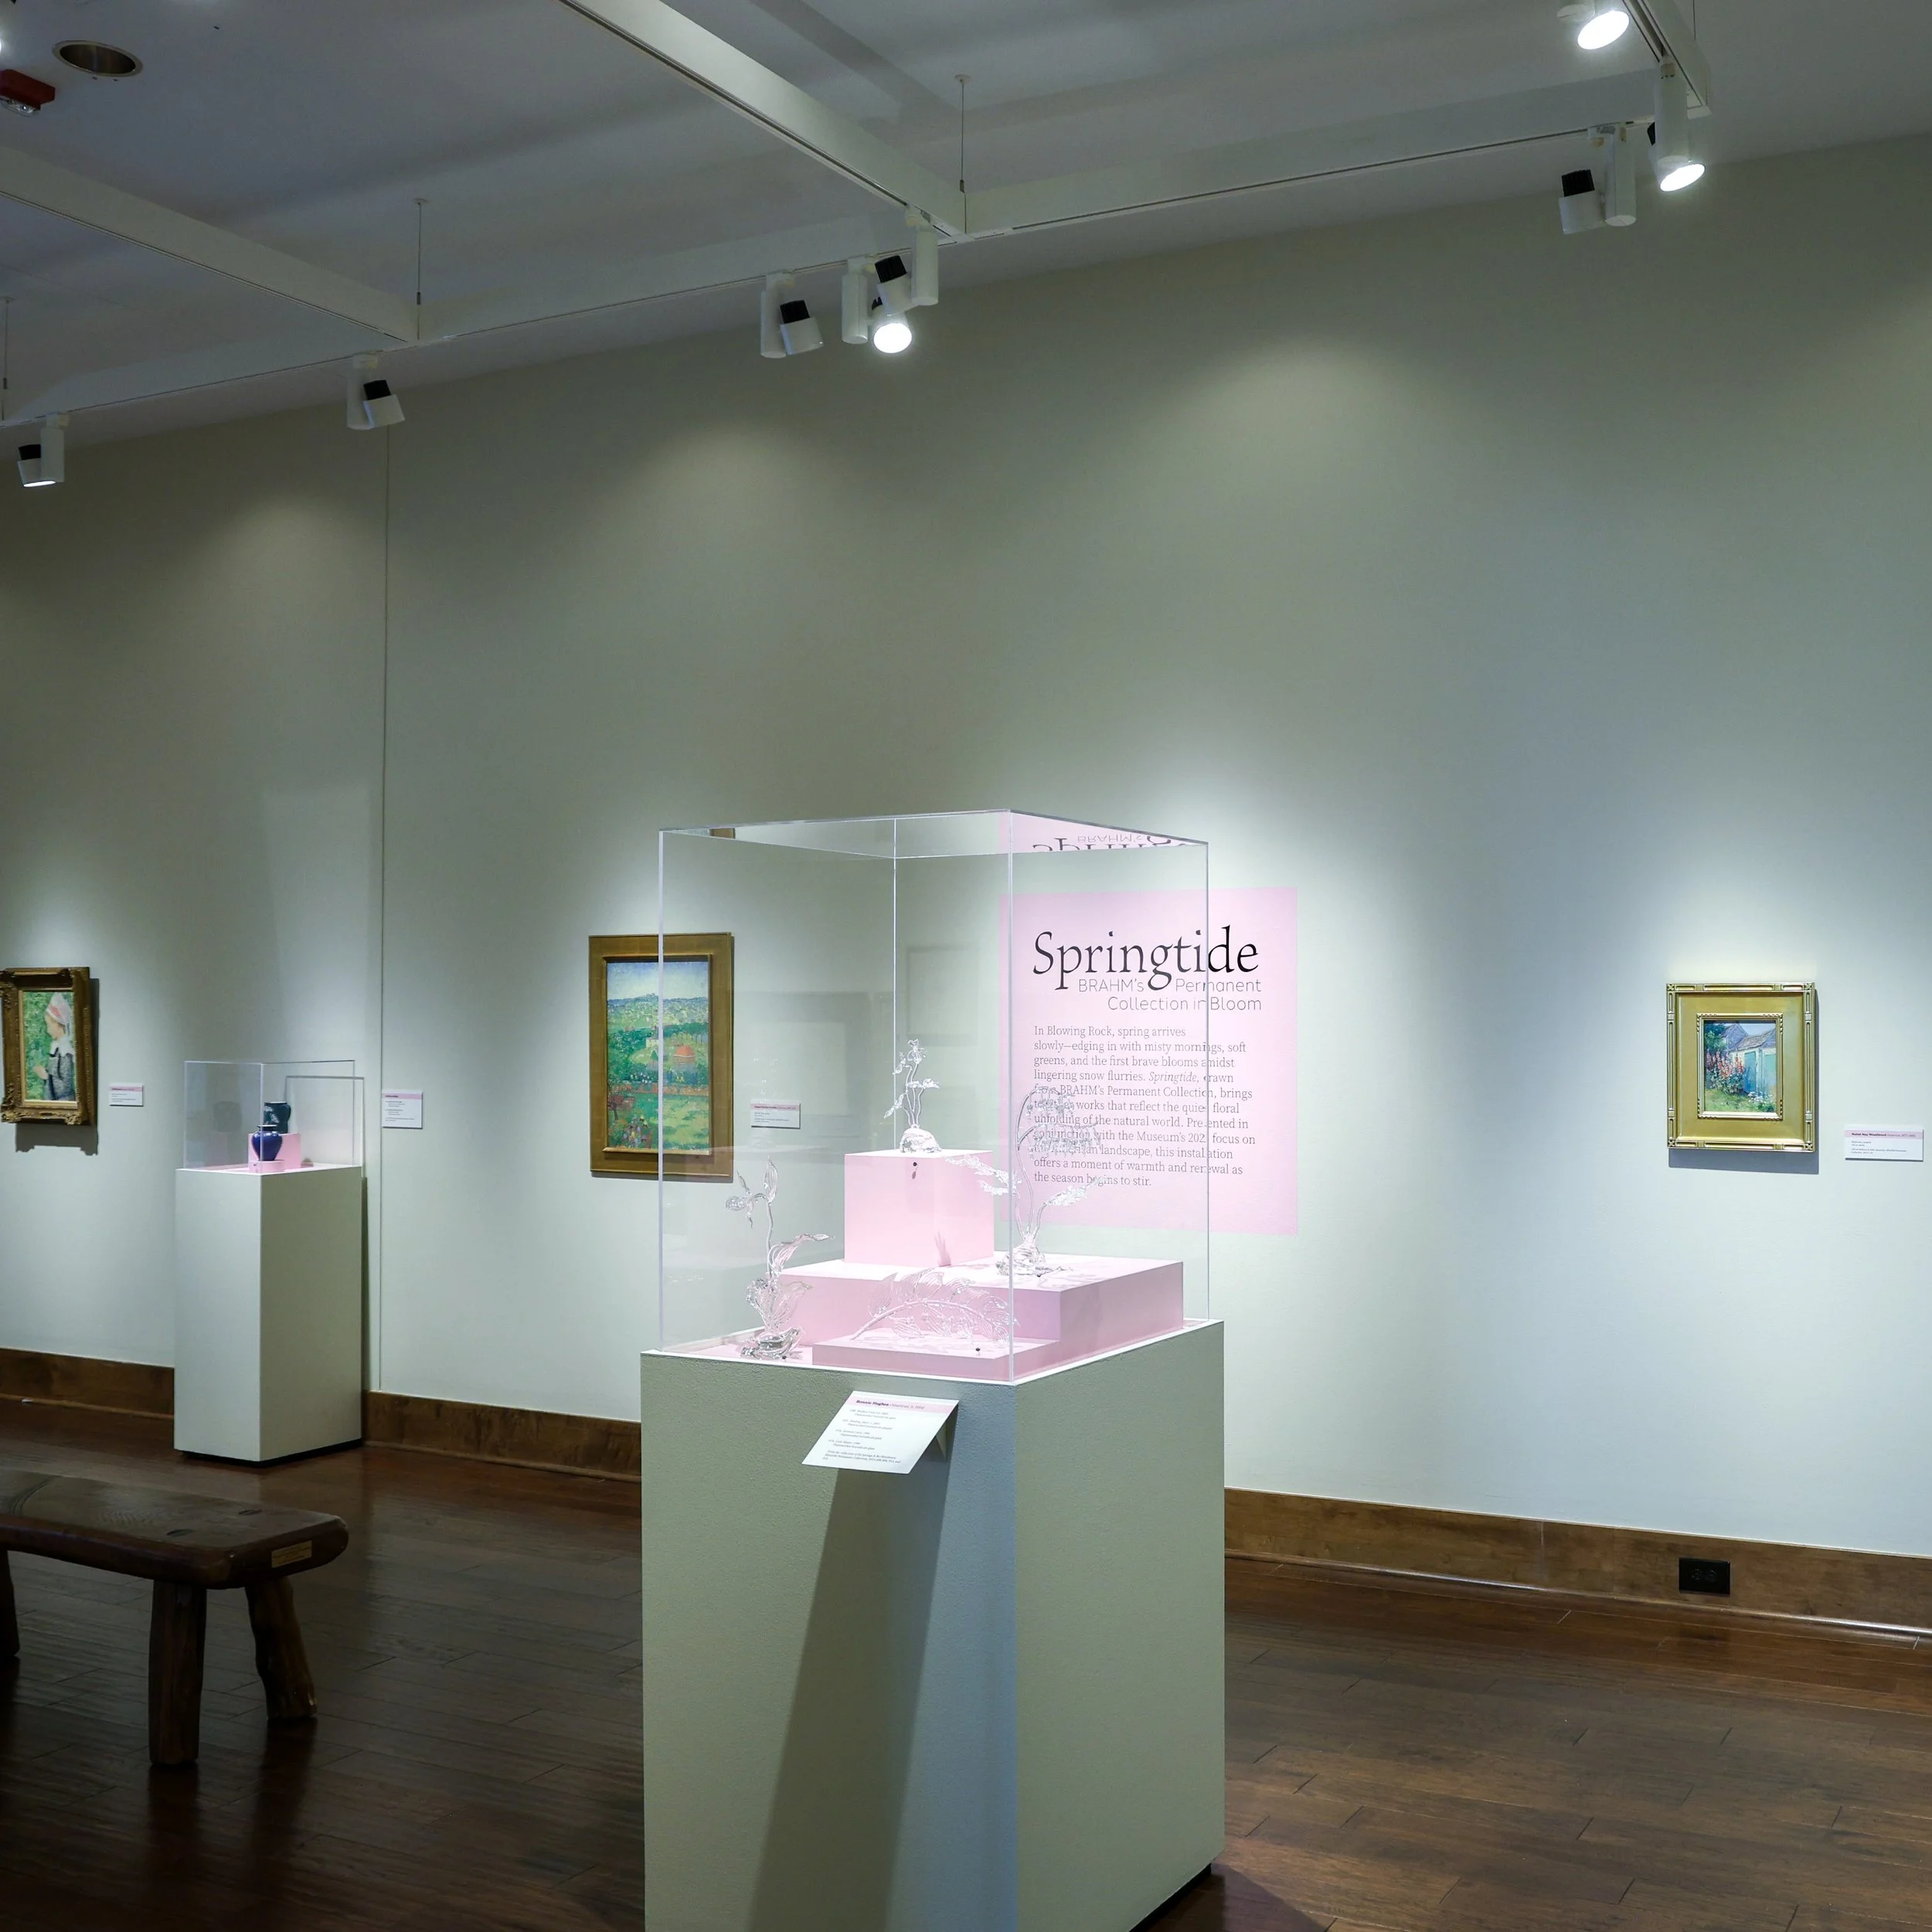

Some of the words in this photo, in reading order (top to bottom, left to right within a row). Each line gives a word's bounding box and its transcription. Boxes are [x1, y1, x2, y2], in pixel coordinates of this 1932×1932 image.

[1033, 925, 1259, 991] Springtide
[1078, 978, 1145, 992] BRAHM's
[1175, 978, 1261, 992] Permanent
[1107, 996, 1188, 1010] Collection
[1210, 997, 1261, 1010] Bloom
[1035, 1026, 1044, 1036] In
[1047, 1026, 1086, 1039] Blowing
[1088, 1026, 1114, 1037] Rock,
[1117, 1026, 1149, 1039] spring
[1151, 1026, 1186, 1036] arrives
[1107, 1041, 1117, 1051] in
[1120, 1041, 1141, 1051] with
[1145, 1042, 1172, 1054] misty
[1227, 1041, 1246, 1052] soft
[1034, 1056, 1068, 1066] greens,
[1070, 1055, 1088, 1066] and
[1091, 1056, 1107, 1066] the
[1110, 1056, 1129, 1066] first
[1132, 1056, 1158, 1066] brave
[1162, 1056, 1198, 1066] blooms
[1034, 1069, 1077, 1082] lingering
[1107, 1070, 1145, 1081] flurries.
[1148, 1072, 1199, 1084] Springtide,
[1060, 1085, 1104, 1095] BRAHM's
[1107, 1086, 1161, 1097] Permanent
[1220, 1087, 1253, 1101] brings
[1077, 1100, 1104, 1110] works
[1108, 1100, 1127, 1111] that
[1130, 1100, 1160, 1111] reflect
[1163, 1101, 1179, 1112] the
[1182, 1103, 1206, 1115] quie
[1213, 1103, 1240, 1114] floral
[1034, 1114, 1080, 1128] unfolding
[1083, 1114, 1094, 1124] of
[1095, 1114, 1111, 1124] the
[1114, 1115, 1150, 1126] natural
[1151, 1116, 1184, 1128] world.
[1187, 1117, 1236, 1128] Preented
[1239, 1119, 1249, 1129] in
[1118, 1129, 1134, 1141] the
[1137, 1131, 1185, 1142] Museum's
[1189, 1133, 1207, 1143] 202
[1213, 1133, 1240, 1144] focus
[1243, 1136, 1255, 1145] on
[1101, 1145, 1152, 1158] landscape,
[1156, 1146, 1175, 1158] this
[1178, 1148, 1233, 1159] instalation
[1034, 1157, 1061, 1167] offers
[1071, 1159, 1112, 1170] moment
[1114, 1160, 1125, 1170] of
[1128, 1161, 1165, 1172] warmth
[1168, 1162, 1187, 1173] and
[1232, 1166, 1243, 1175] as
[1034, 1172, 1049, 1182] the
[1052, 1174, 1083, 1183] season
[1121, 1175, 1132, 1185] to
[1133, 1175, 1151, 1186] stir.
